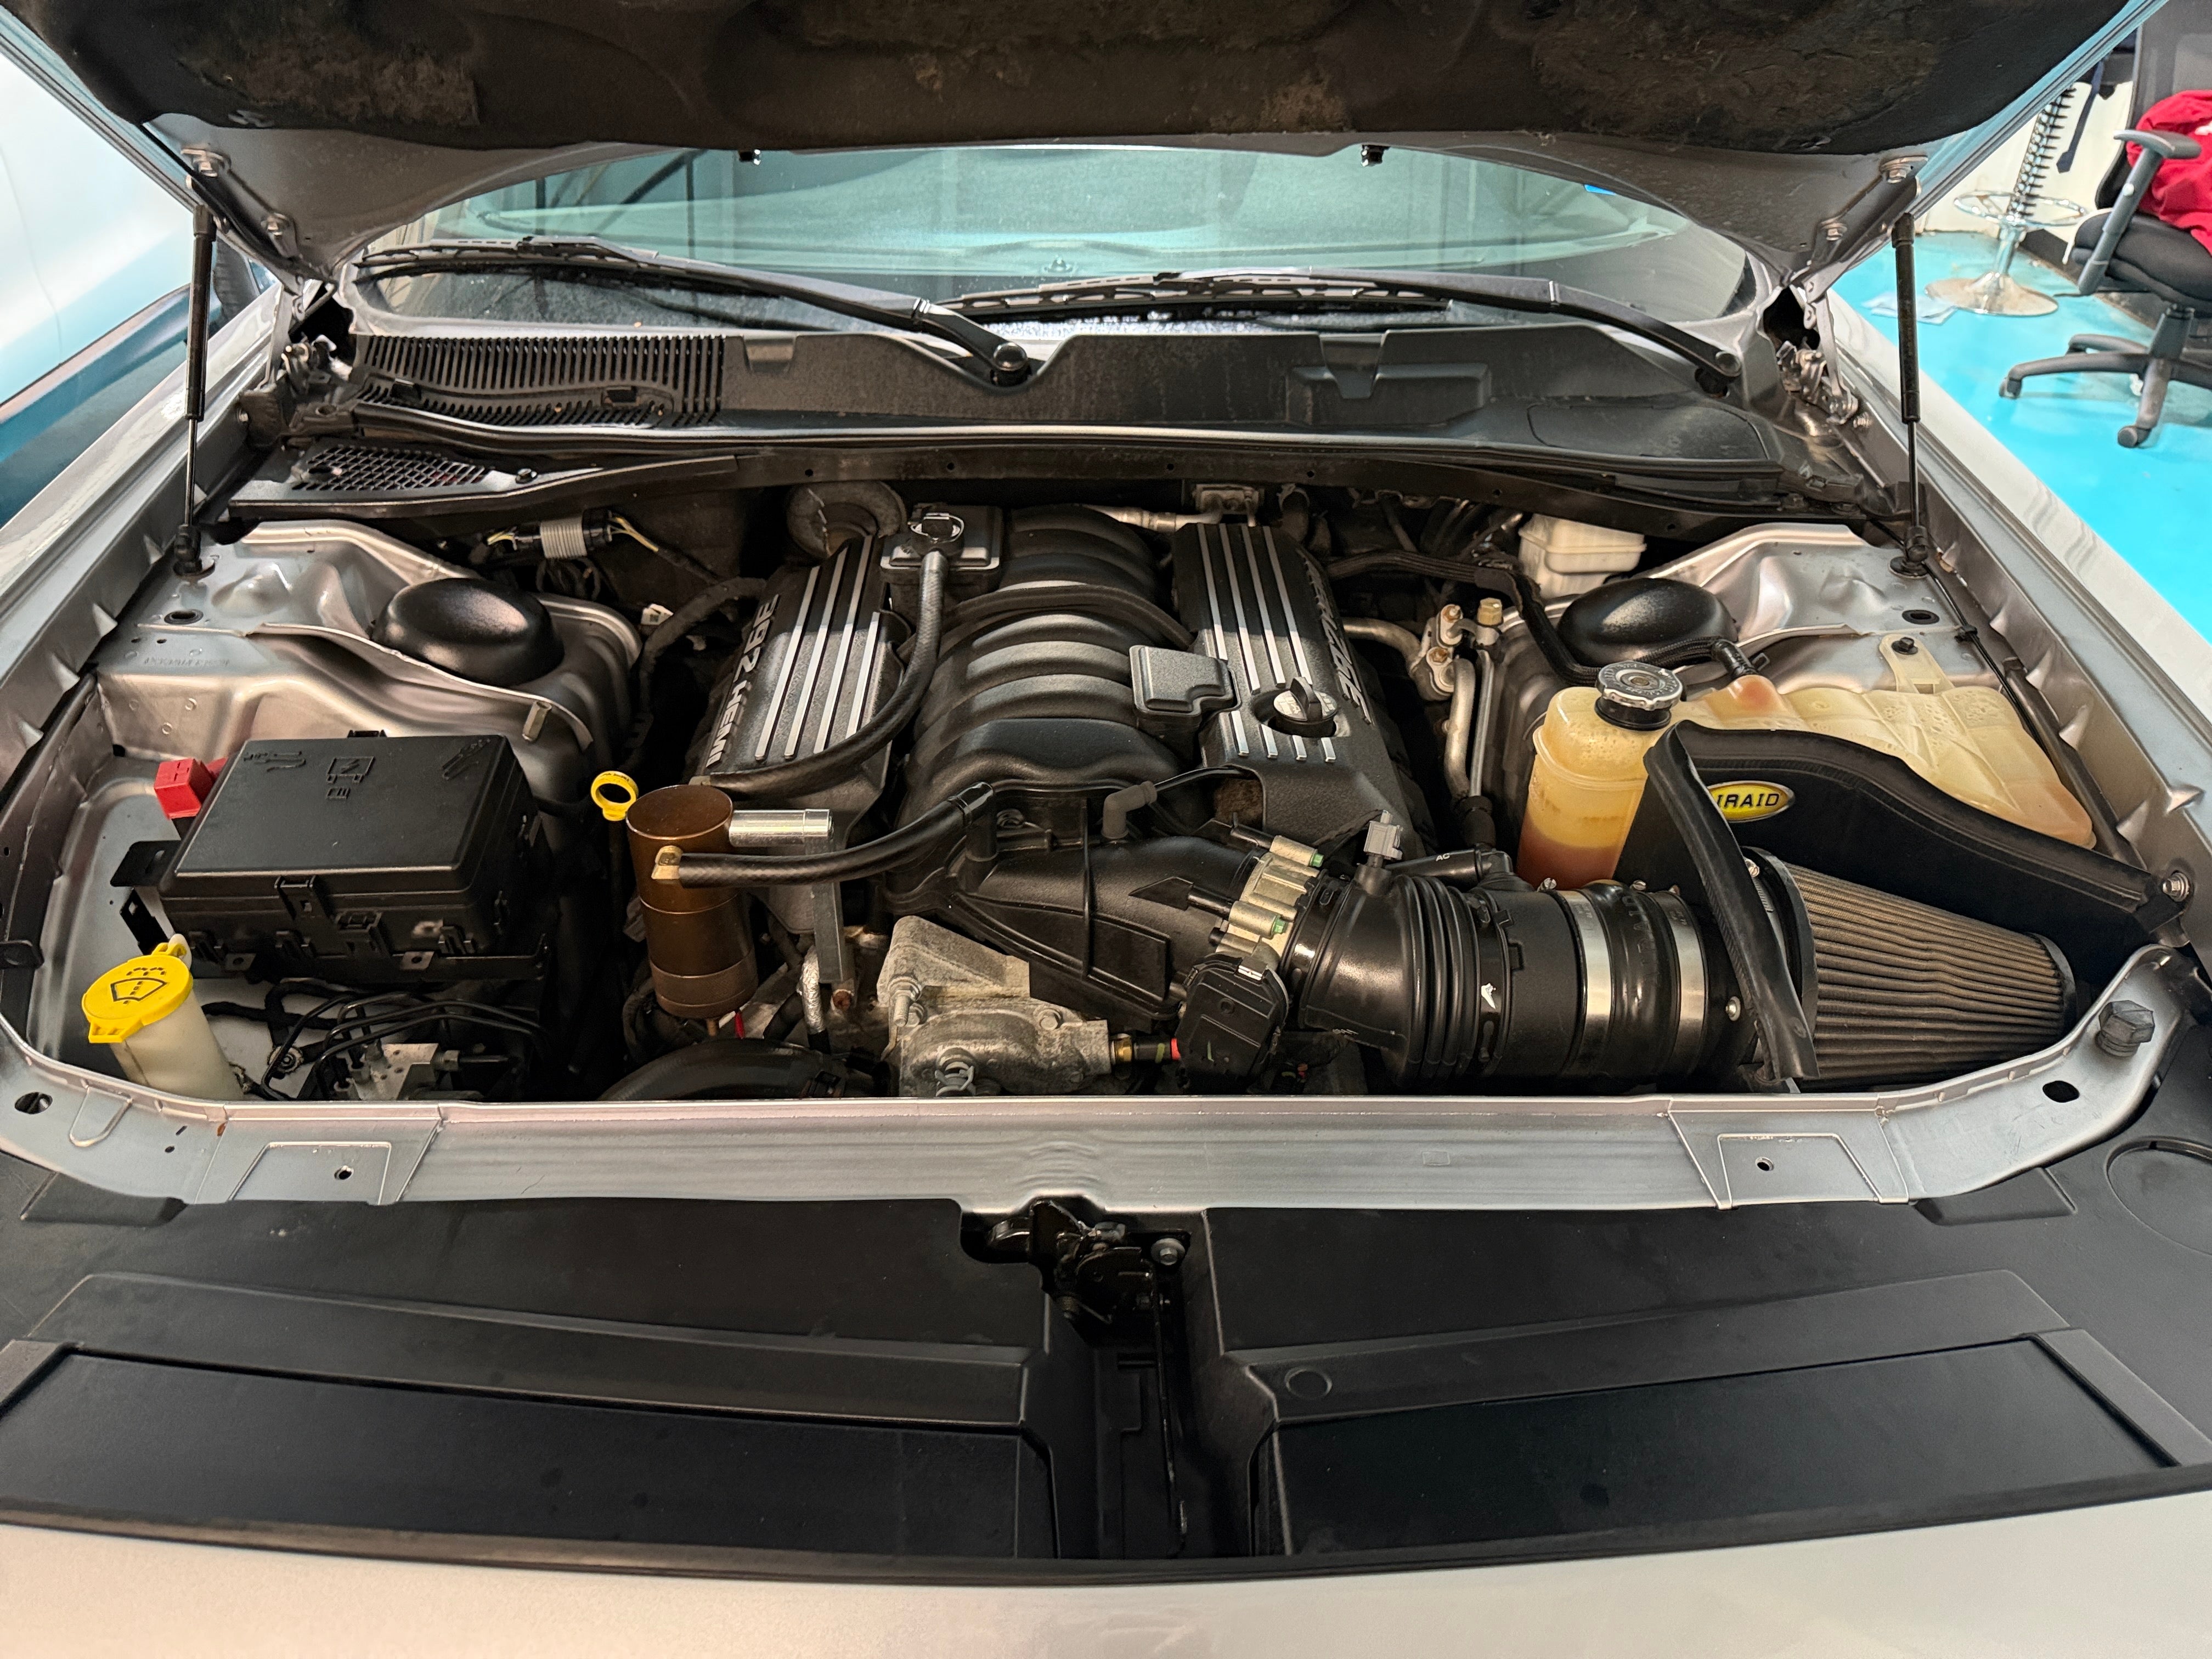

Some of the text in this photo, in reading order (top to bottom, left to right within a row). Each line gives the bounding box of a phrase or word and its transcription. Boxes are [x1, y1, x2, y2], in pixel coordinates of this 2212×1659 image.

[706, 594, 779, 768] 392 HEMI
[1716, 793, 1780, 808] IRAID
[1435, 853, 1451, 862] AC
